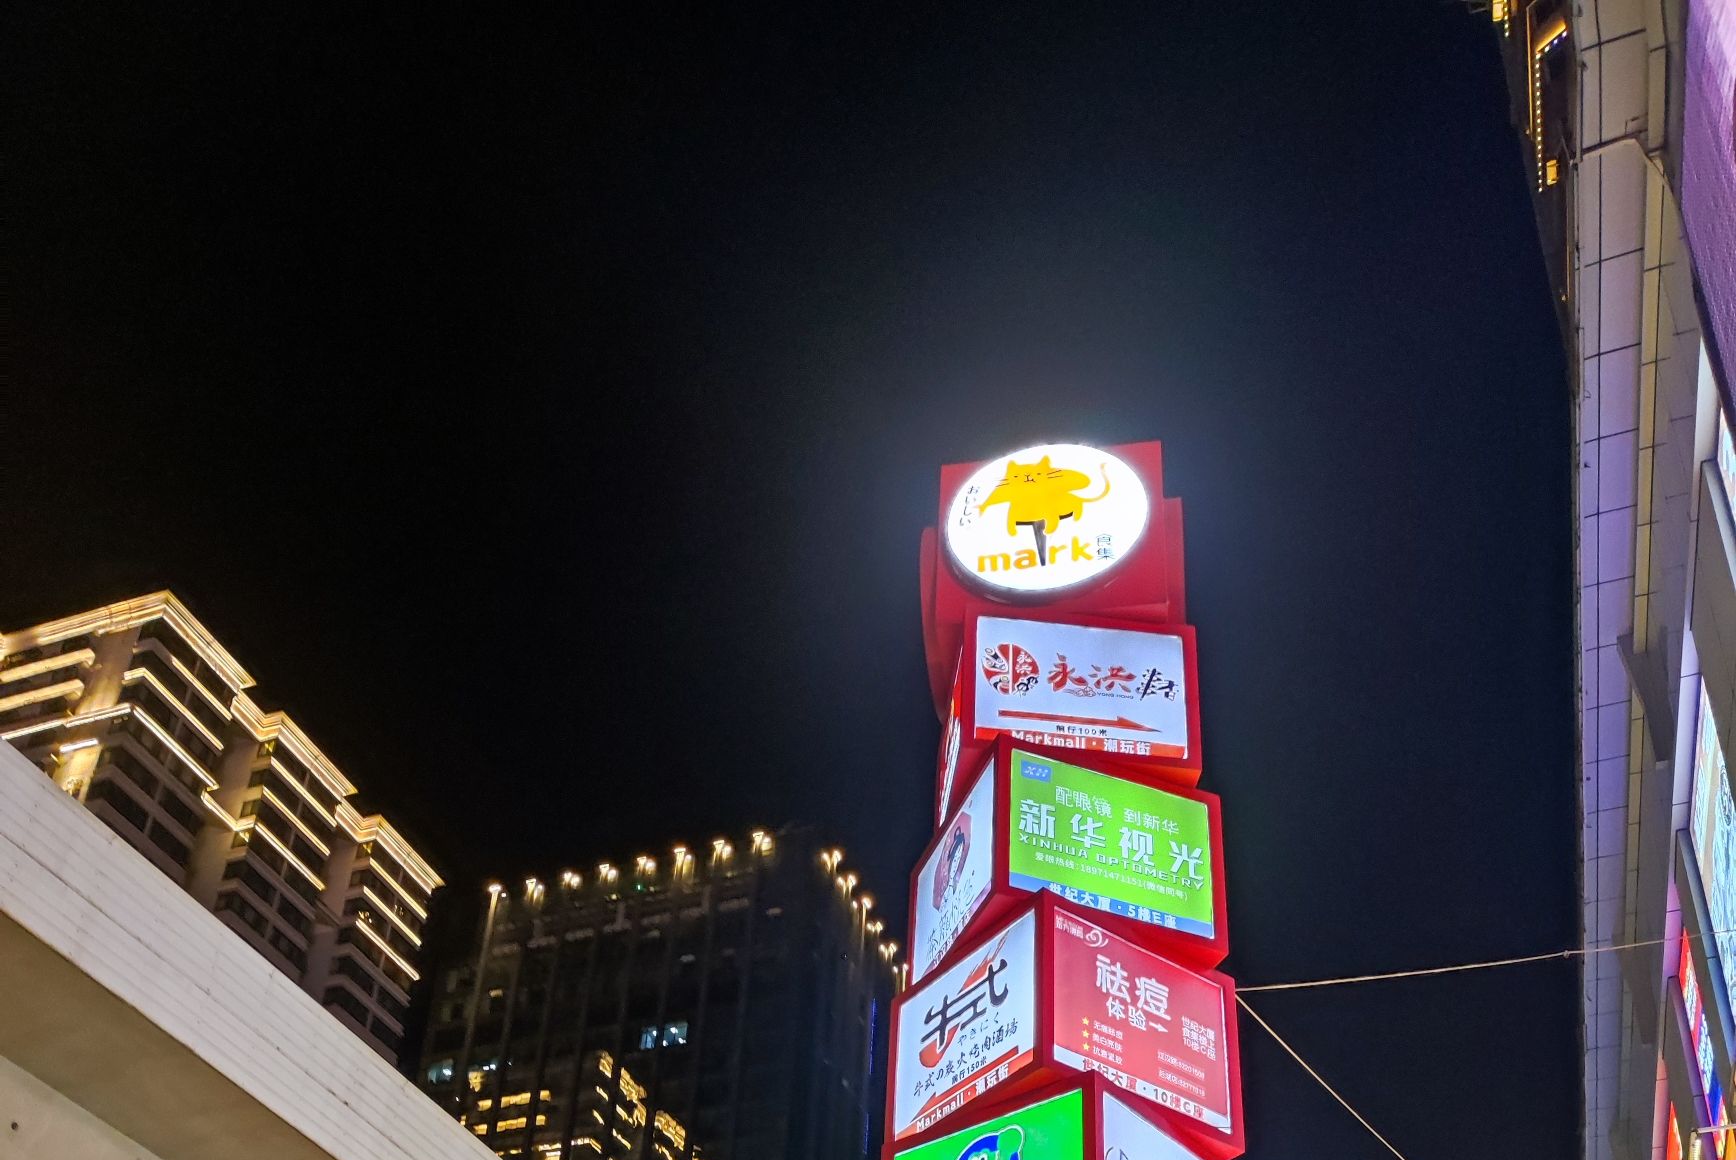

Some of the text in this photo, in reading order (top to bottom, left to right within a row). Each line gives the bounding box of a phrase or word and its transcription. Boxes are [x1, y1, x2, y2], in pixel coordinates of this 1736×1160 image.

[977, 535, 1094, 573] mark
[1055, 785, 1180, 835] 配眼镜 到新华
[1018, 799, 1204, 881] 新华视光
[1018, 832, 1205, 891] XINHUA OPTOMETRY
[1096, 953, 1171, 1021] 祛痘
[1106, 997, 1147, 1031] 体验
